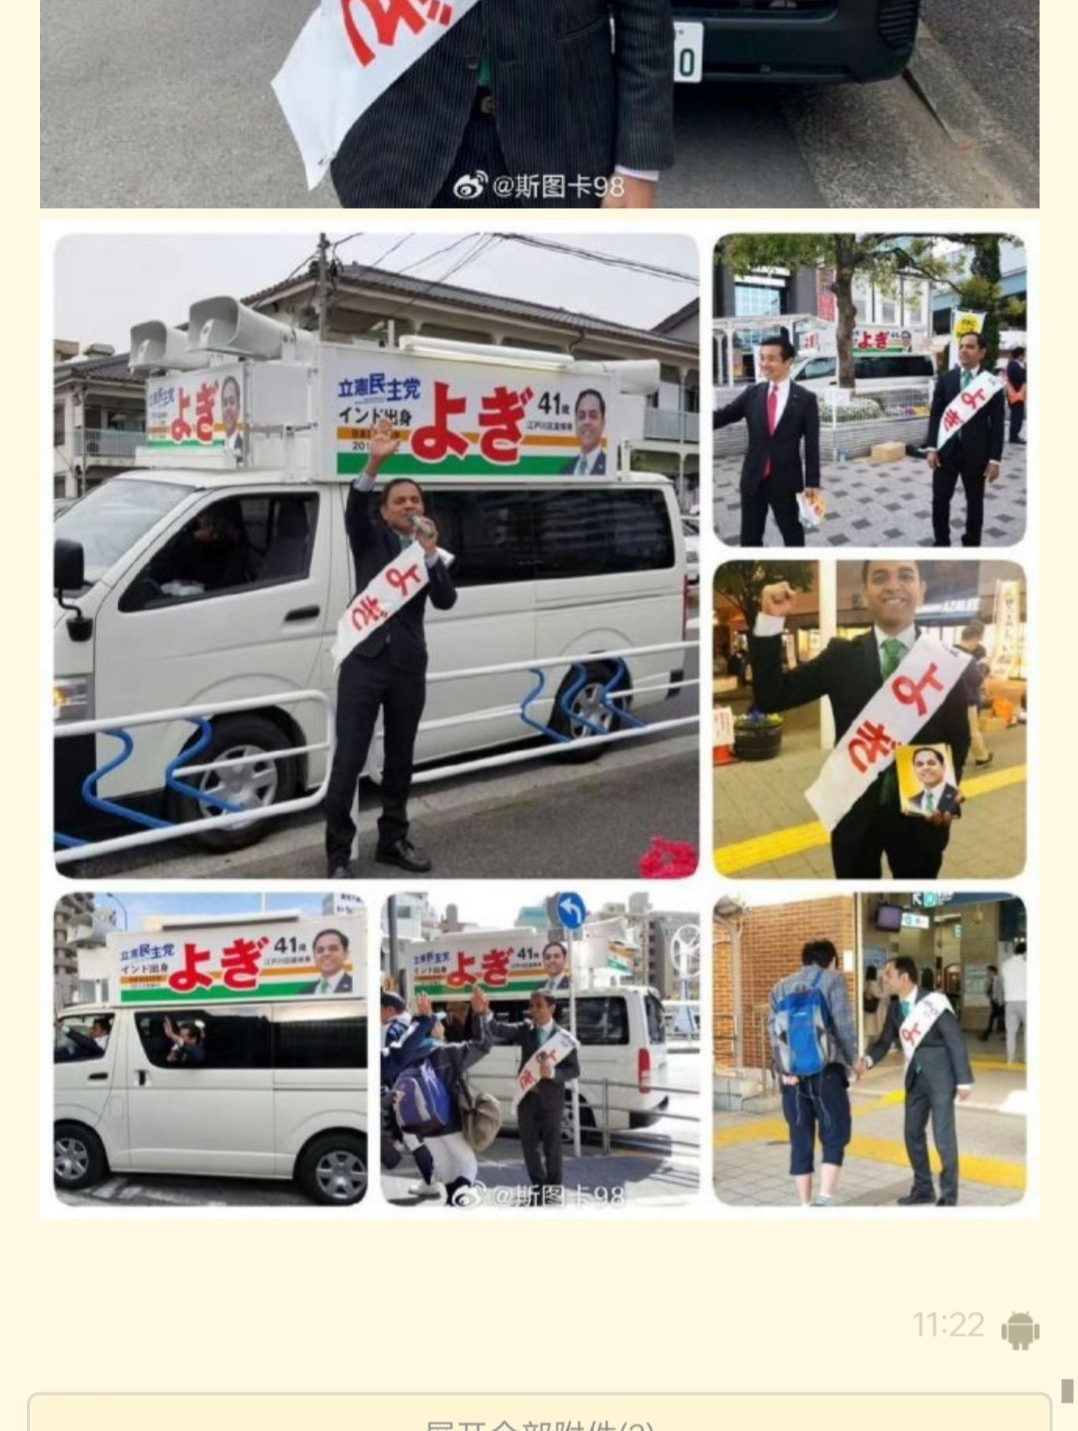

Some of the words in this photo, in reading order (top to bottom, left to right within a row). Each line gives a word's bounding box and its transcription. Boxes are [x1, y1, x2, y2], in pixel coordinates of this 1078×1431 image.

[171, 381, 218, 442] よぎ
[338, 372, 421, 402] 立憲民主党
[411, 381, 535, 463] よぎ
[351, 564, 421, 632] よぎ
[168, 936, 270, 992] よぎ
[447, 947, 514, 988] よぎ
[913, 1312, 985, 1338] 11:22
